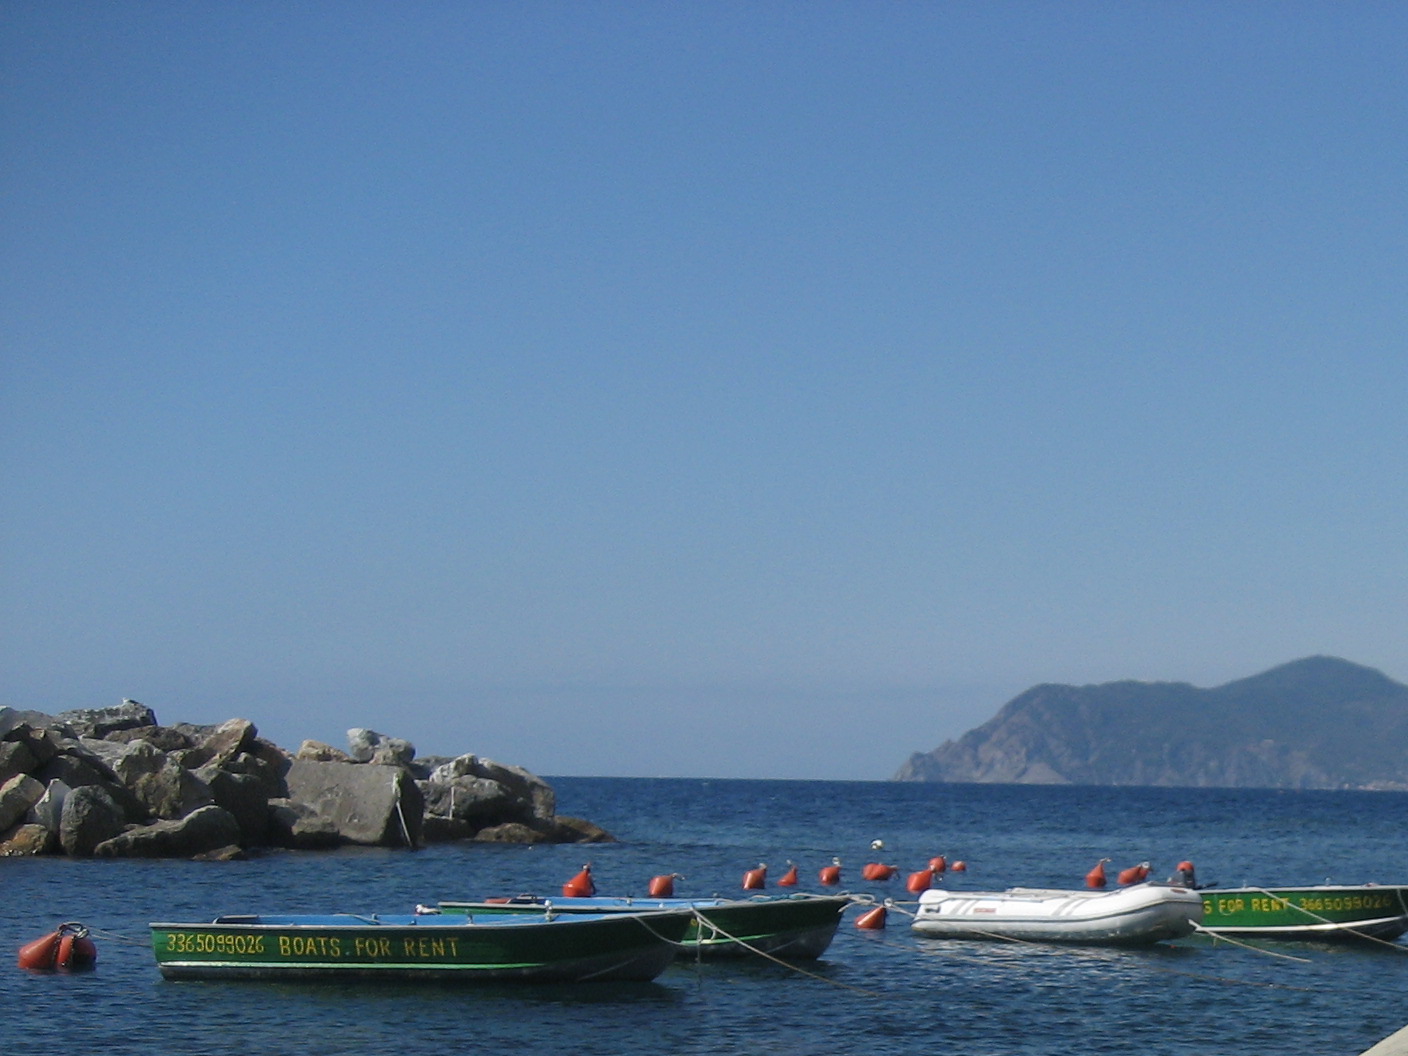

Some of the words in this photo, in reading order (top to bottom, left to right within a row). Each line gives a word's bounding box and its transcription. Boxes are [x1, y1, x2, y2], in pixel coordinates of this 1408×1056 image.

[1218, 898, 1244, 913] FOR
[1251, 897, 1289, 912] RENT
[166, 933, 265, 954] 3365099026
[278, 935, 341, 957] BOATS
[354, 937, 392, 957] FOR
[403, 937, 459, 957] RENT
